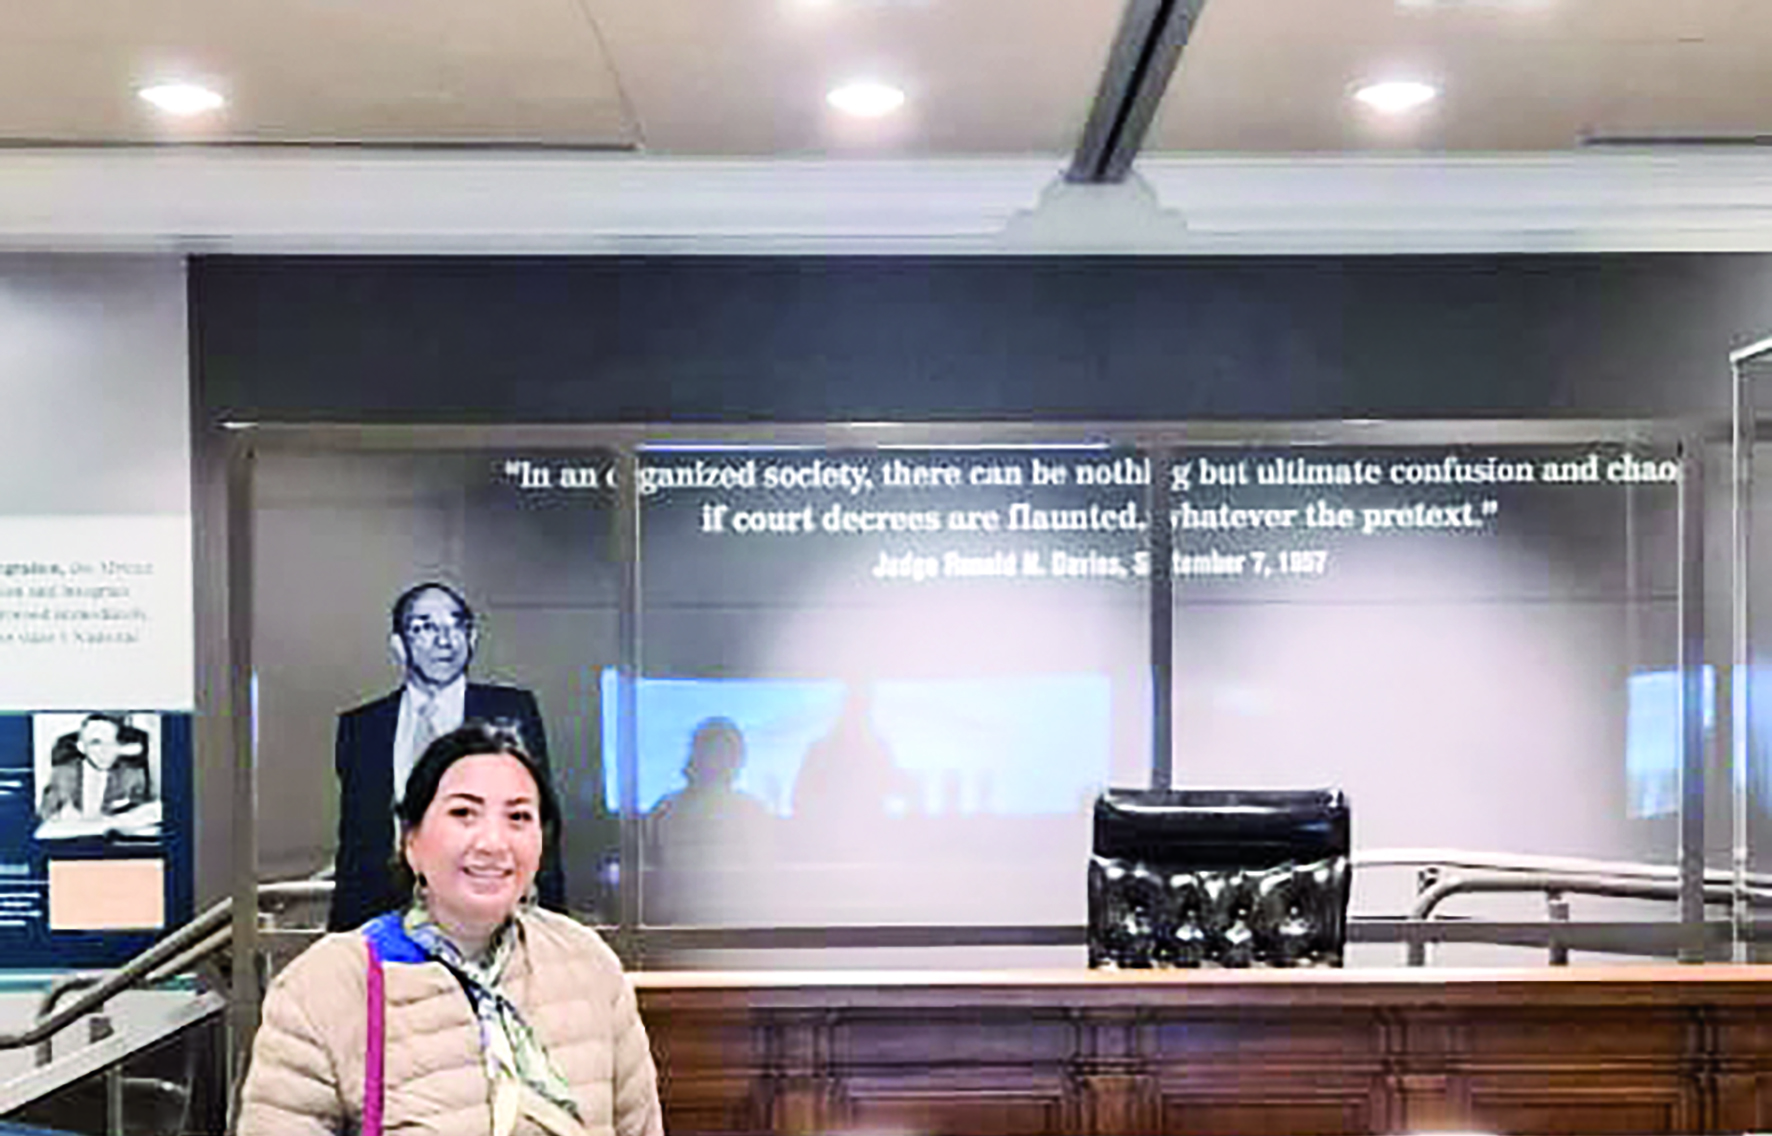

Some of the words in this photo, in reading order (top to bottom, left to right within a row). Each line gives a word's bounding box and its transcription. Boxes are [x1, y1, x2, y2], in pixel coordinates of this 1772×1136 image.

[561, 467, 599, 489] an
[606, 460, 756, 495] oganized
[763, 459, 873, 495] society,
[883, 459, 960, 487] there
[970, 465, 1022, 486] can
[1033, 458, 1067, 486] be
[1077, 457, 1192, 492] nothig
[1200, 457, 1249, 486] but
[1258, 457, 1383, 486] ultimate
[1390, 456, 1534, 484] confusion
[1541, 453, 1600, 482] and
[703, 504, 728, 532] if
[732, 504, 815, 532] court
[822, 503, 941, 531] decrees
[949, 510, 1000, 532] are
[1306, 499, 1354, 528] the
[872, 551, 938, 582] Judge
[943, 551, 1017, 577] Ronald
[1052, 551, 1129, 580] Davies,
[1132, 550, 1246, 577] Stember
[1250, 550, 1272, 579] 7,
